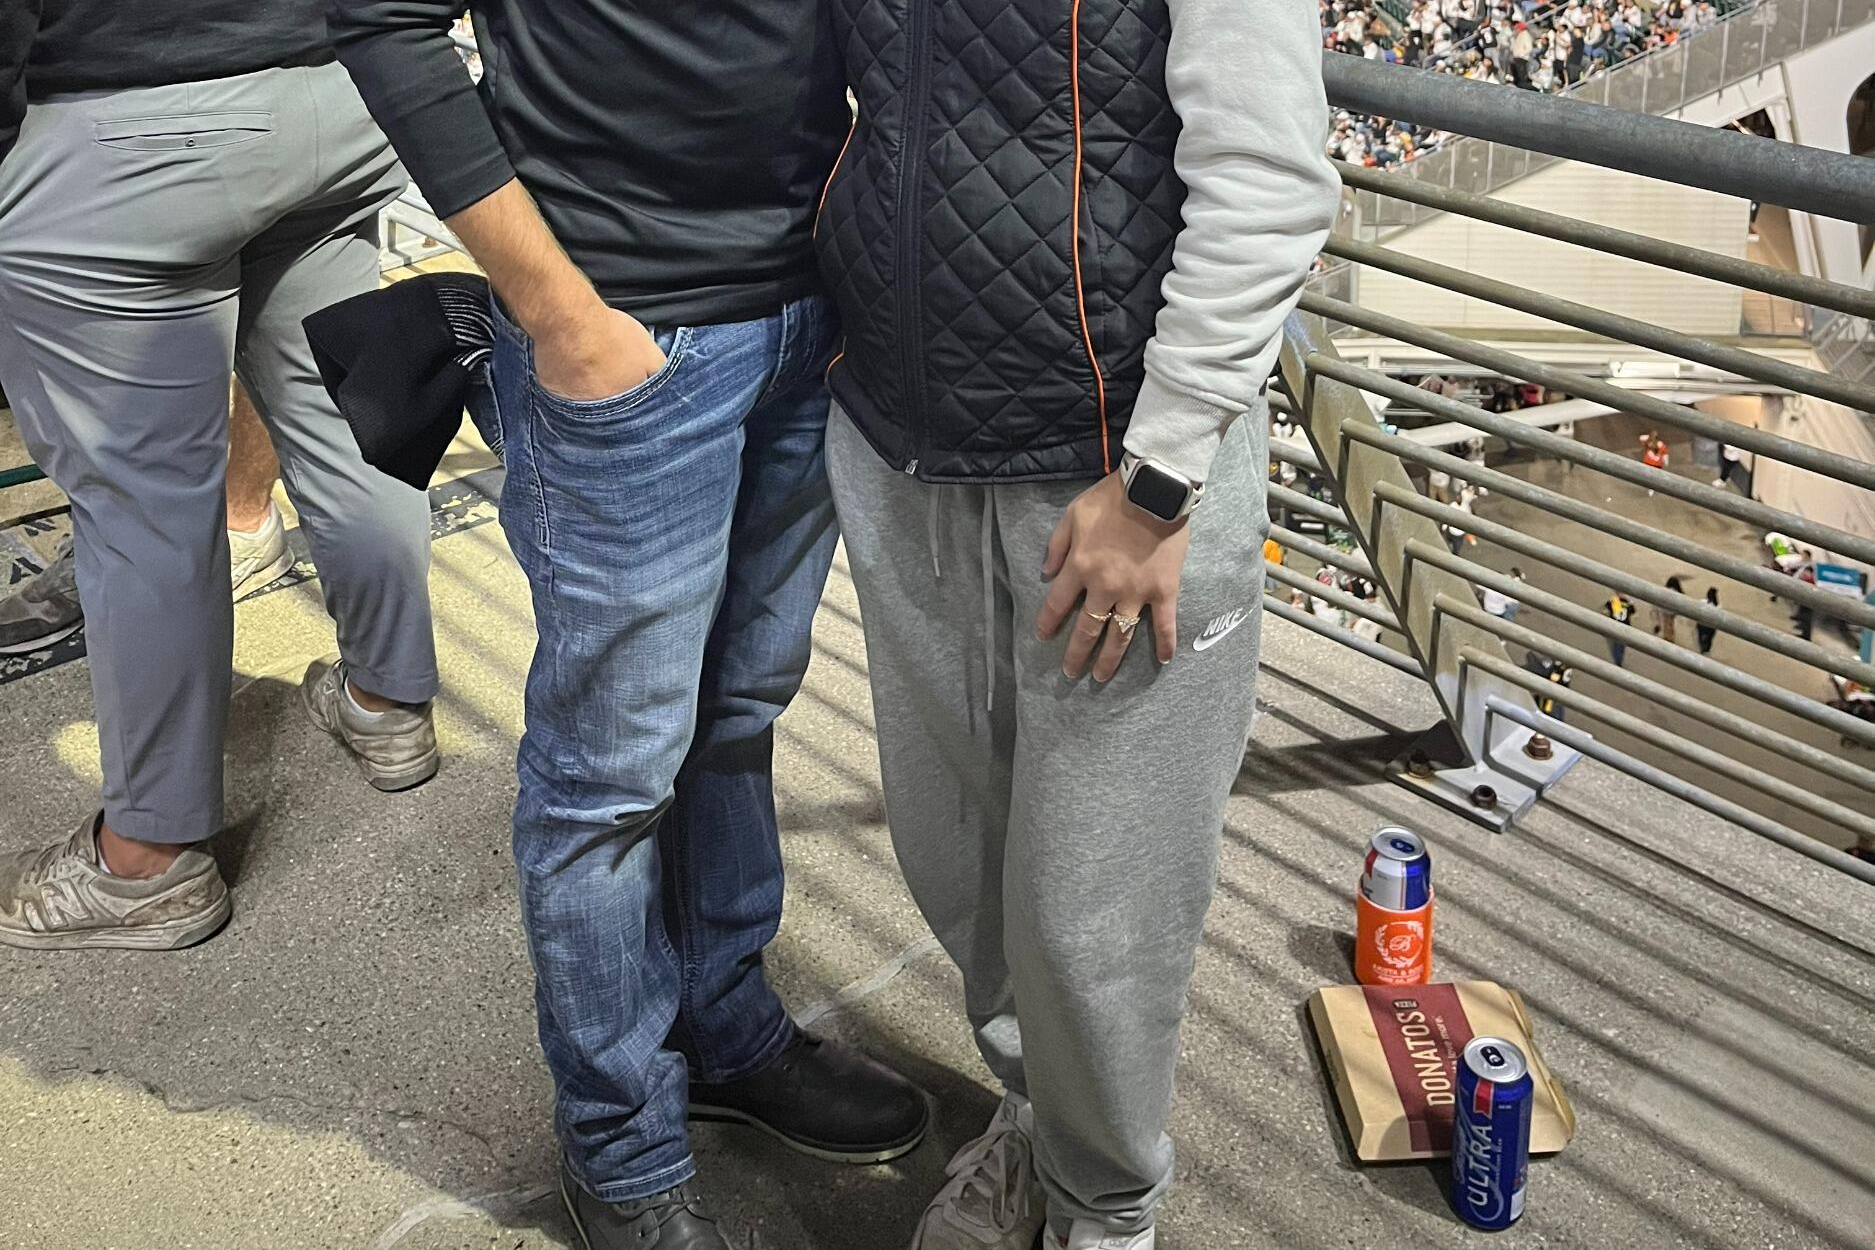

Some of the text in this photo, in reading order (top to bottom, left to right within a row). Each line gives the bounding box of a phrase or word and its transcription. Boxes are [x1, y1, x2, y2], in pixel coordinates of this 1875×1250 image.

[1203, 607, 1243, 637] NIKE
[1396, 1011, 1455, 1106] DONATOS
[1467, 1125, 1492, 1205] ULTRA
